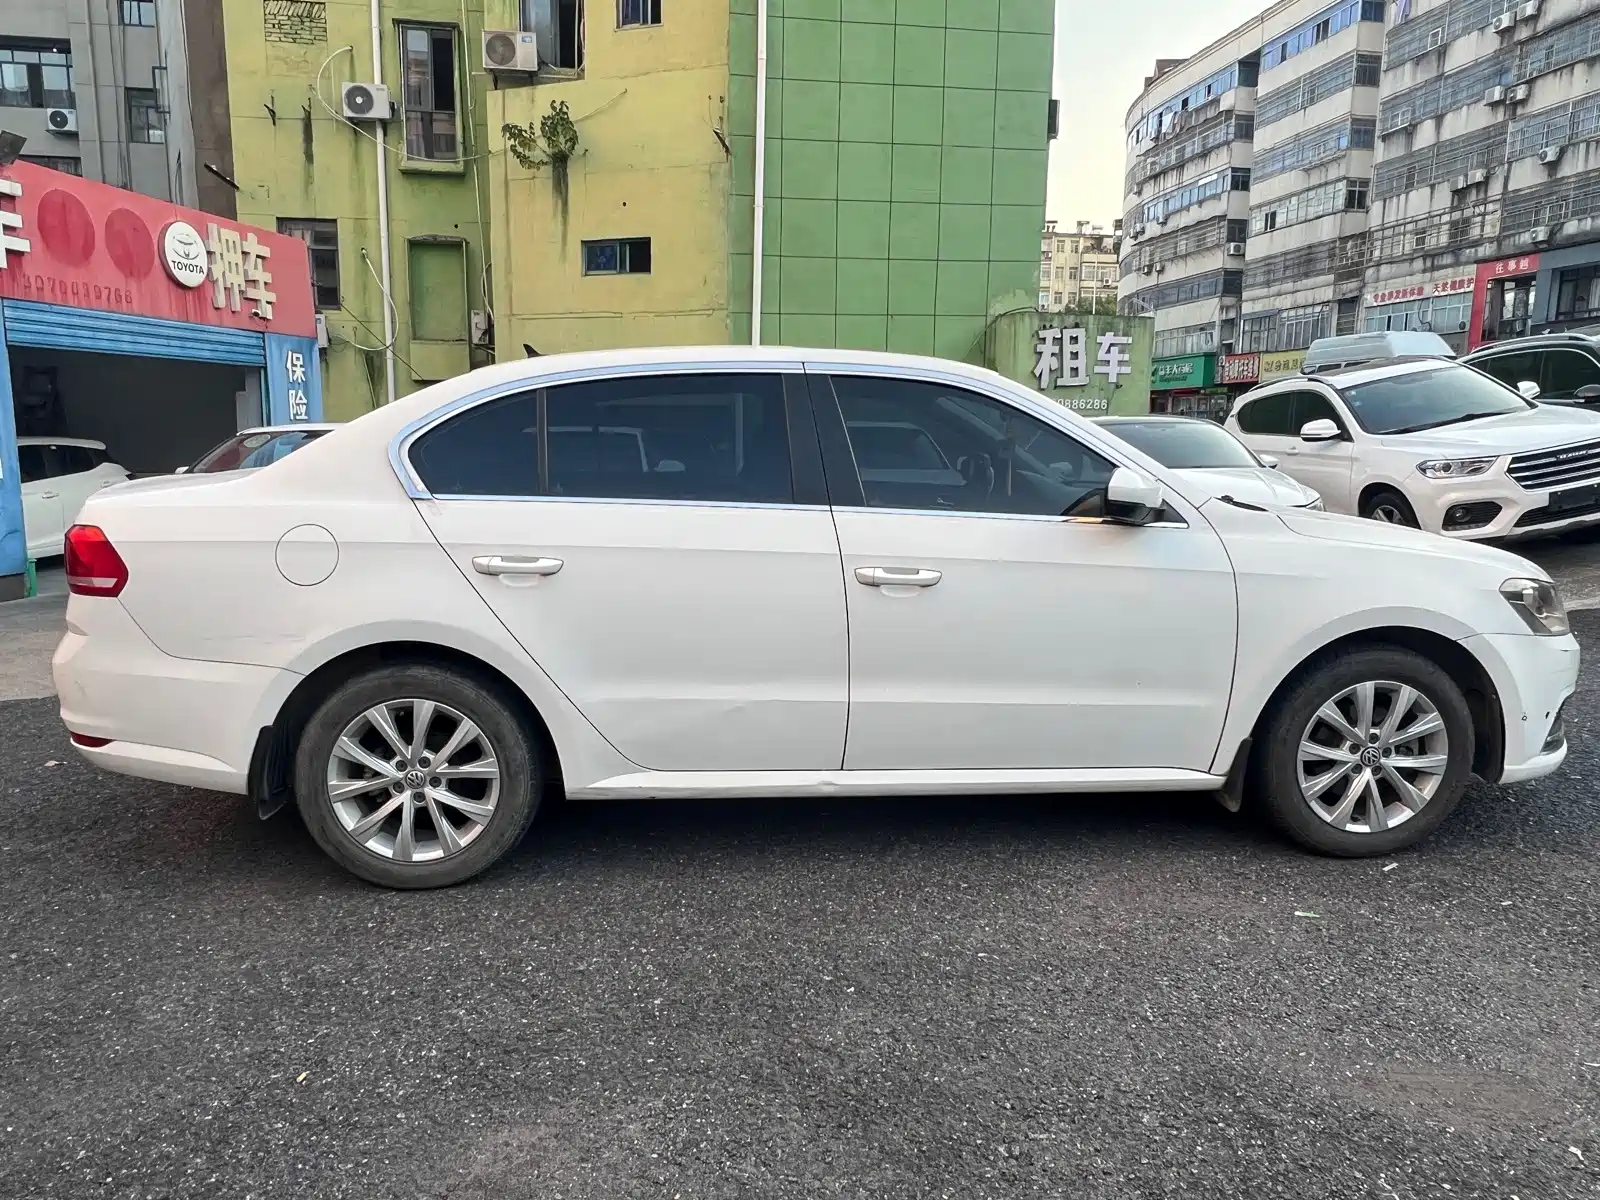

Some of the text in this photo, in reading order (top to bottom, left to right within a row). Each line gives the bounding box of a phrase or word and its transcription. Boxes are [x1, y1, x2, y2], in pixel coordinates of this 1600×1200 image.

[171, 259, 205, 275] TOYOTA
[206, 222, 277, 320] 押车
[286, 350, 308, 420] 保险
[1033, 328, 1133, 389] 租车
